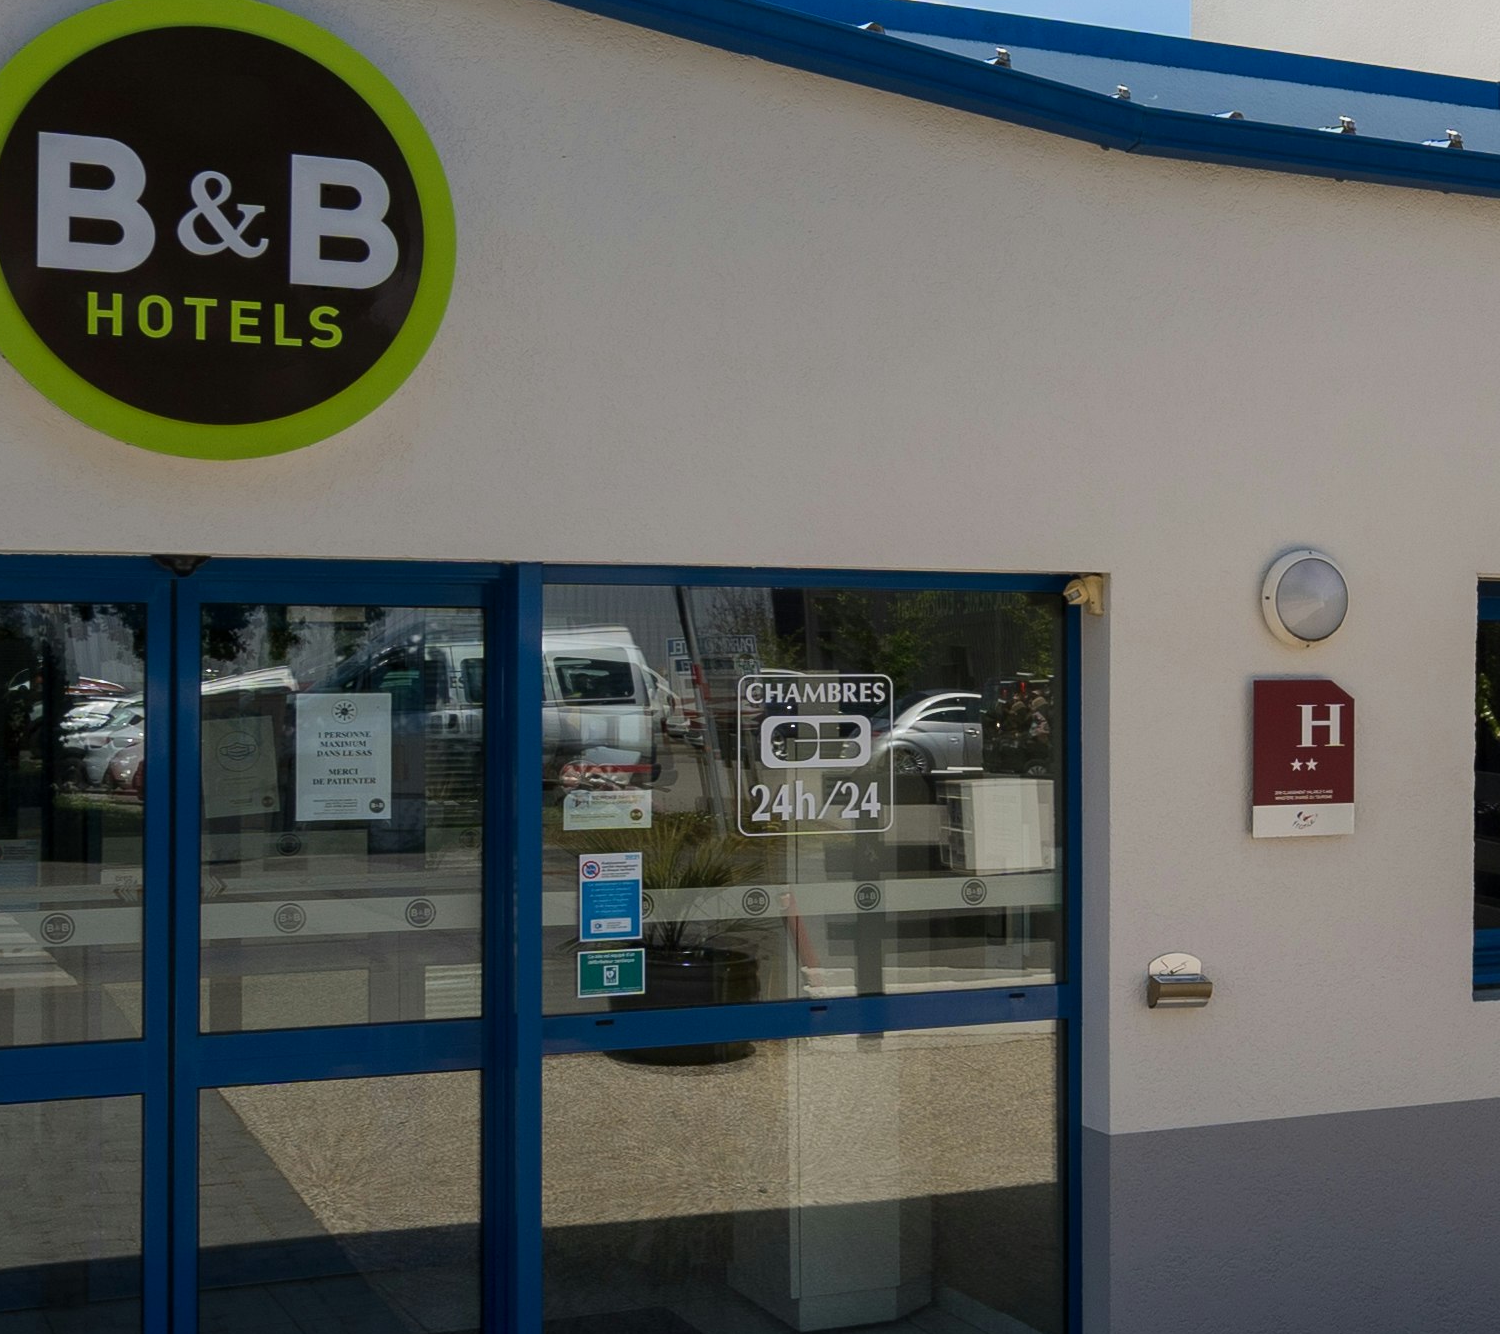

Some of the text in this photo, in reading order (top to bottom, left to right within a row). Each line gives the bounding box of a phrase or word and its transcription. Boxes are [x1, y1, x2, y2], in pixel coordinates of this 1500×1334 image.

[86, 291, 343, 348] HOTELS
[746, 682, 886, 704] CHAMBRES
[1296, 704, 1345, 747] H
[312, 777, 376, 786] DE PATIENTER
[328, 768, 359, 776] MERCI
[750, 780, 882, 823] 24h/24
